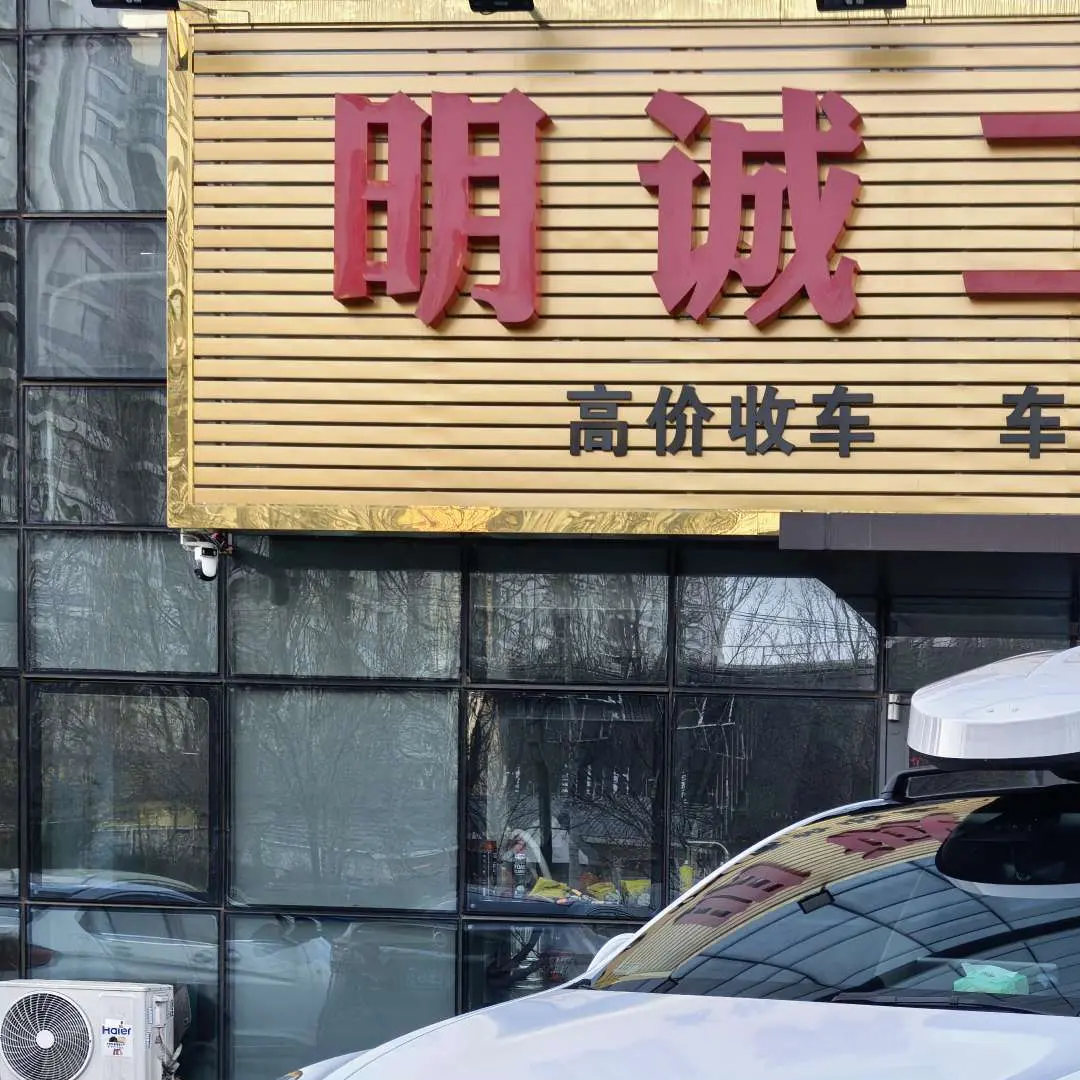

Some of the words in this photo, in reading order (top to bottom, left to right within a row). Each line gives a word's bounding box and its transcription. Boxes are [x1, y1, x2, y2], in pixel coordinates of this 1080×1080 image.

[567, 384, 875, 457] 高价收车
[102, 1024, 132, 1035] Haier
